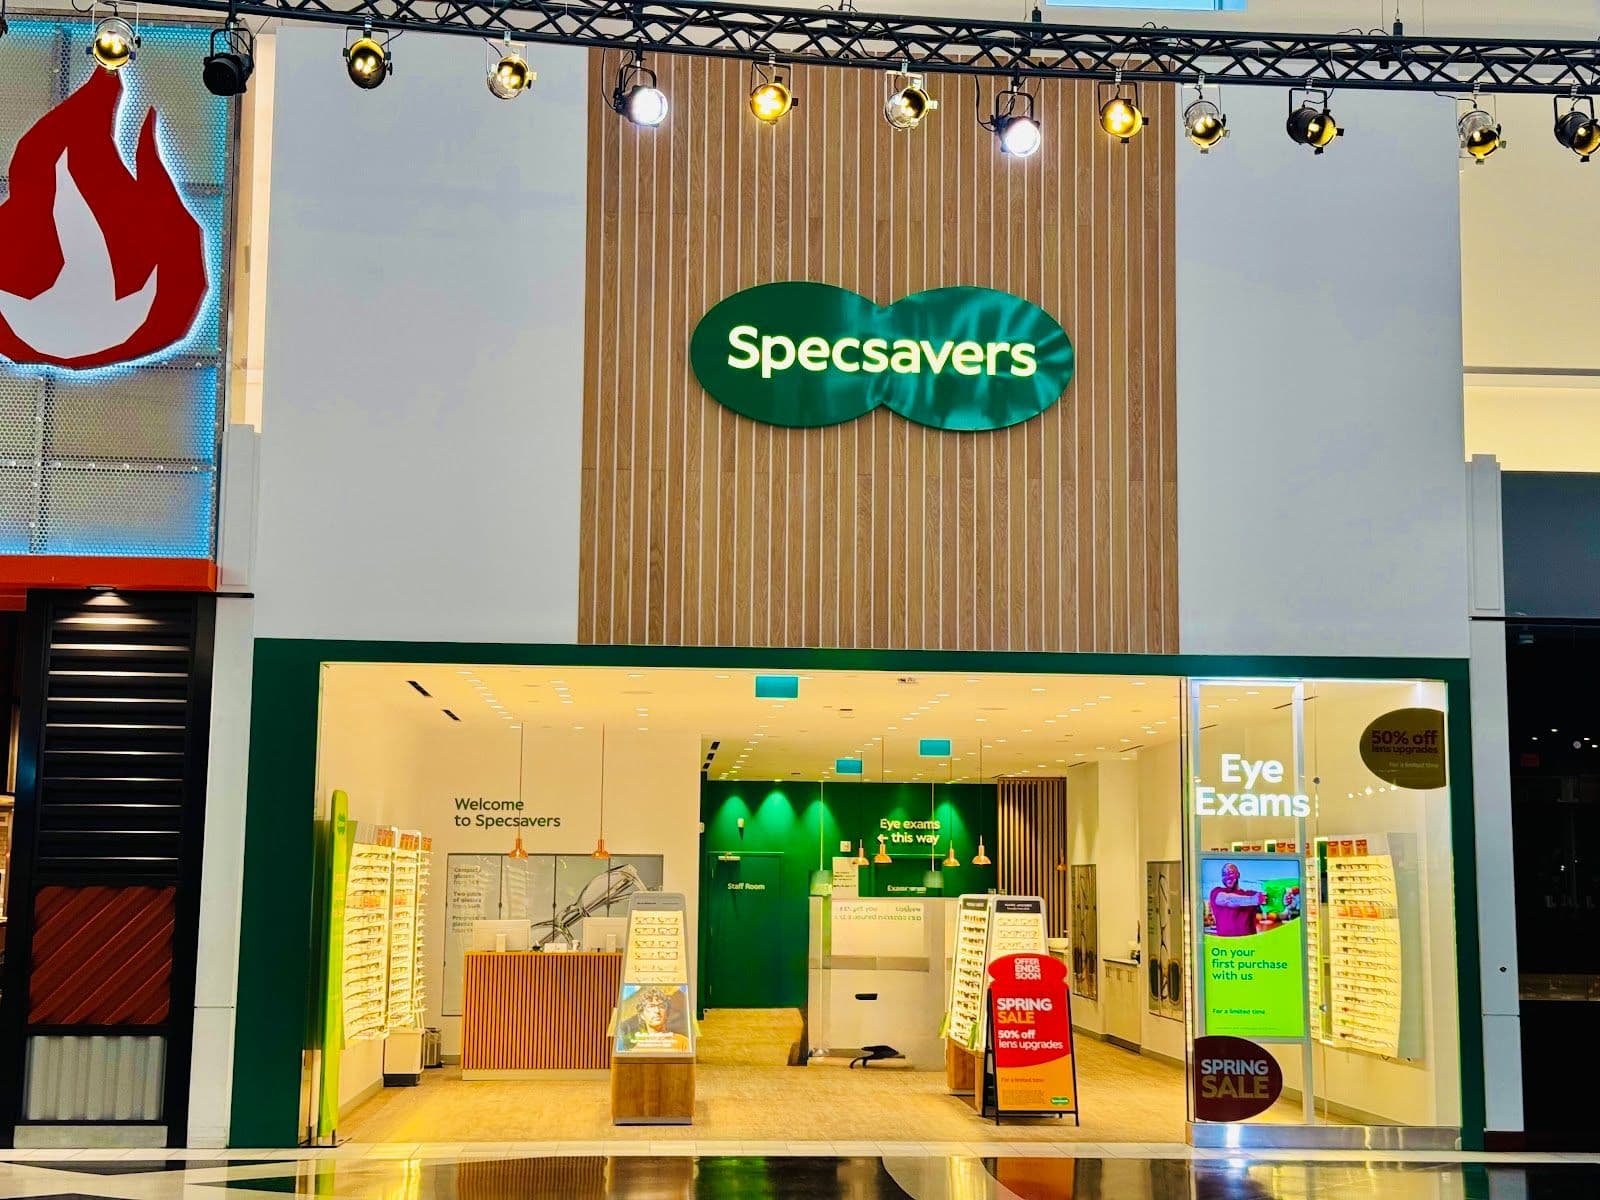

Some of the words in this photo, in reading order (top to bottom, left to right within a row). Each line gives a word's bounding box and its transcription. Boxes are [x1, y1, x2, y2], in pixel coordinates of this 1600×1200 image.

[728, 325, 1037, 378] Specsavers
[1371, 729, 1409, 745] 50%
[1412, 729, 1438, 745] off
[1371, 744, 1391, 753] lens
[1392, 745, 1439, 755] upgrades
[1221, 753, 1284, 790] Eye
[454, 798, 525, 810] Welcome
[1195, 787, 1311, 817] Exams
[454, 815, 471, 827] to
[475, 814, 561, 829] Specsavers
[880, 818, 901, 831] Eye
[903, 820, 940, 830] exams
[891, 832, 913, 843] this
[915, 834, 940, 845] way
[727, 882, 744, 890] Staff
[1211, 947, 1227, 957] On
[1230, 949, 1255, 958] your
[1014, 958, 1040, 966] OFFER
[1212, 958, 1235, 969] first
[1238, 960, 1288, 970] purchase
[1014, 965, 1041, 973] ENDS
[1212, 970, 1237, 980] with
[1014, 972, 1041, 980] SOON
[996, 997, 1053, 1012] SPRING
[997, 1011, 1035, 1024] SALE
[997, 1029, 1020, 1039] 50%
[1021, 1029, 1036, 1039] off
[998, 1039, 1018, 1049] lens
[1019, 1040, 1064, 1051] upgrades
[1200, 1058, 1269, 1075] SPRING
[1201, 1075, 1270, 1098] SALE
